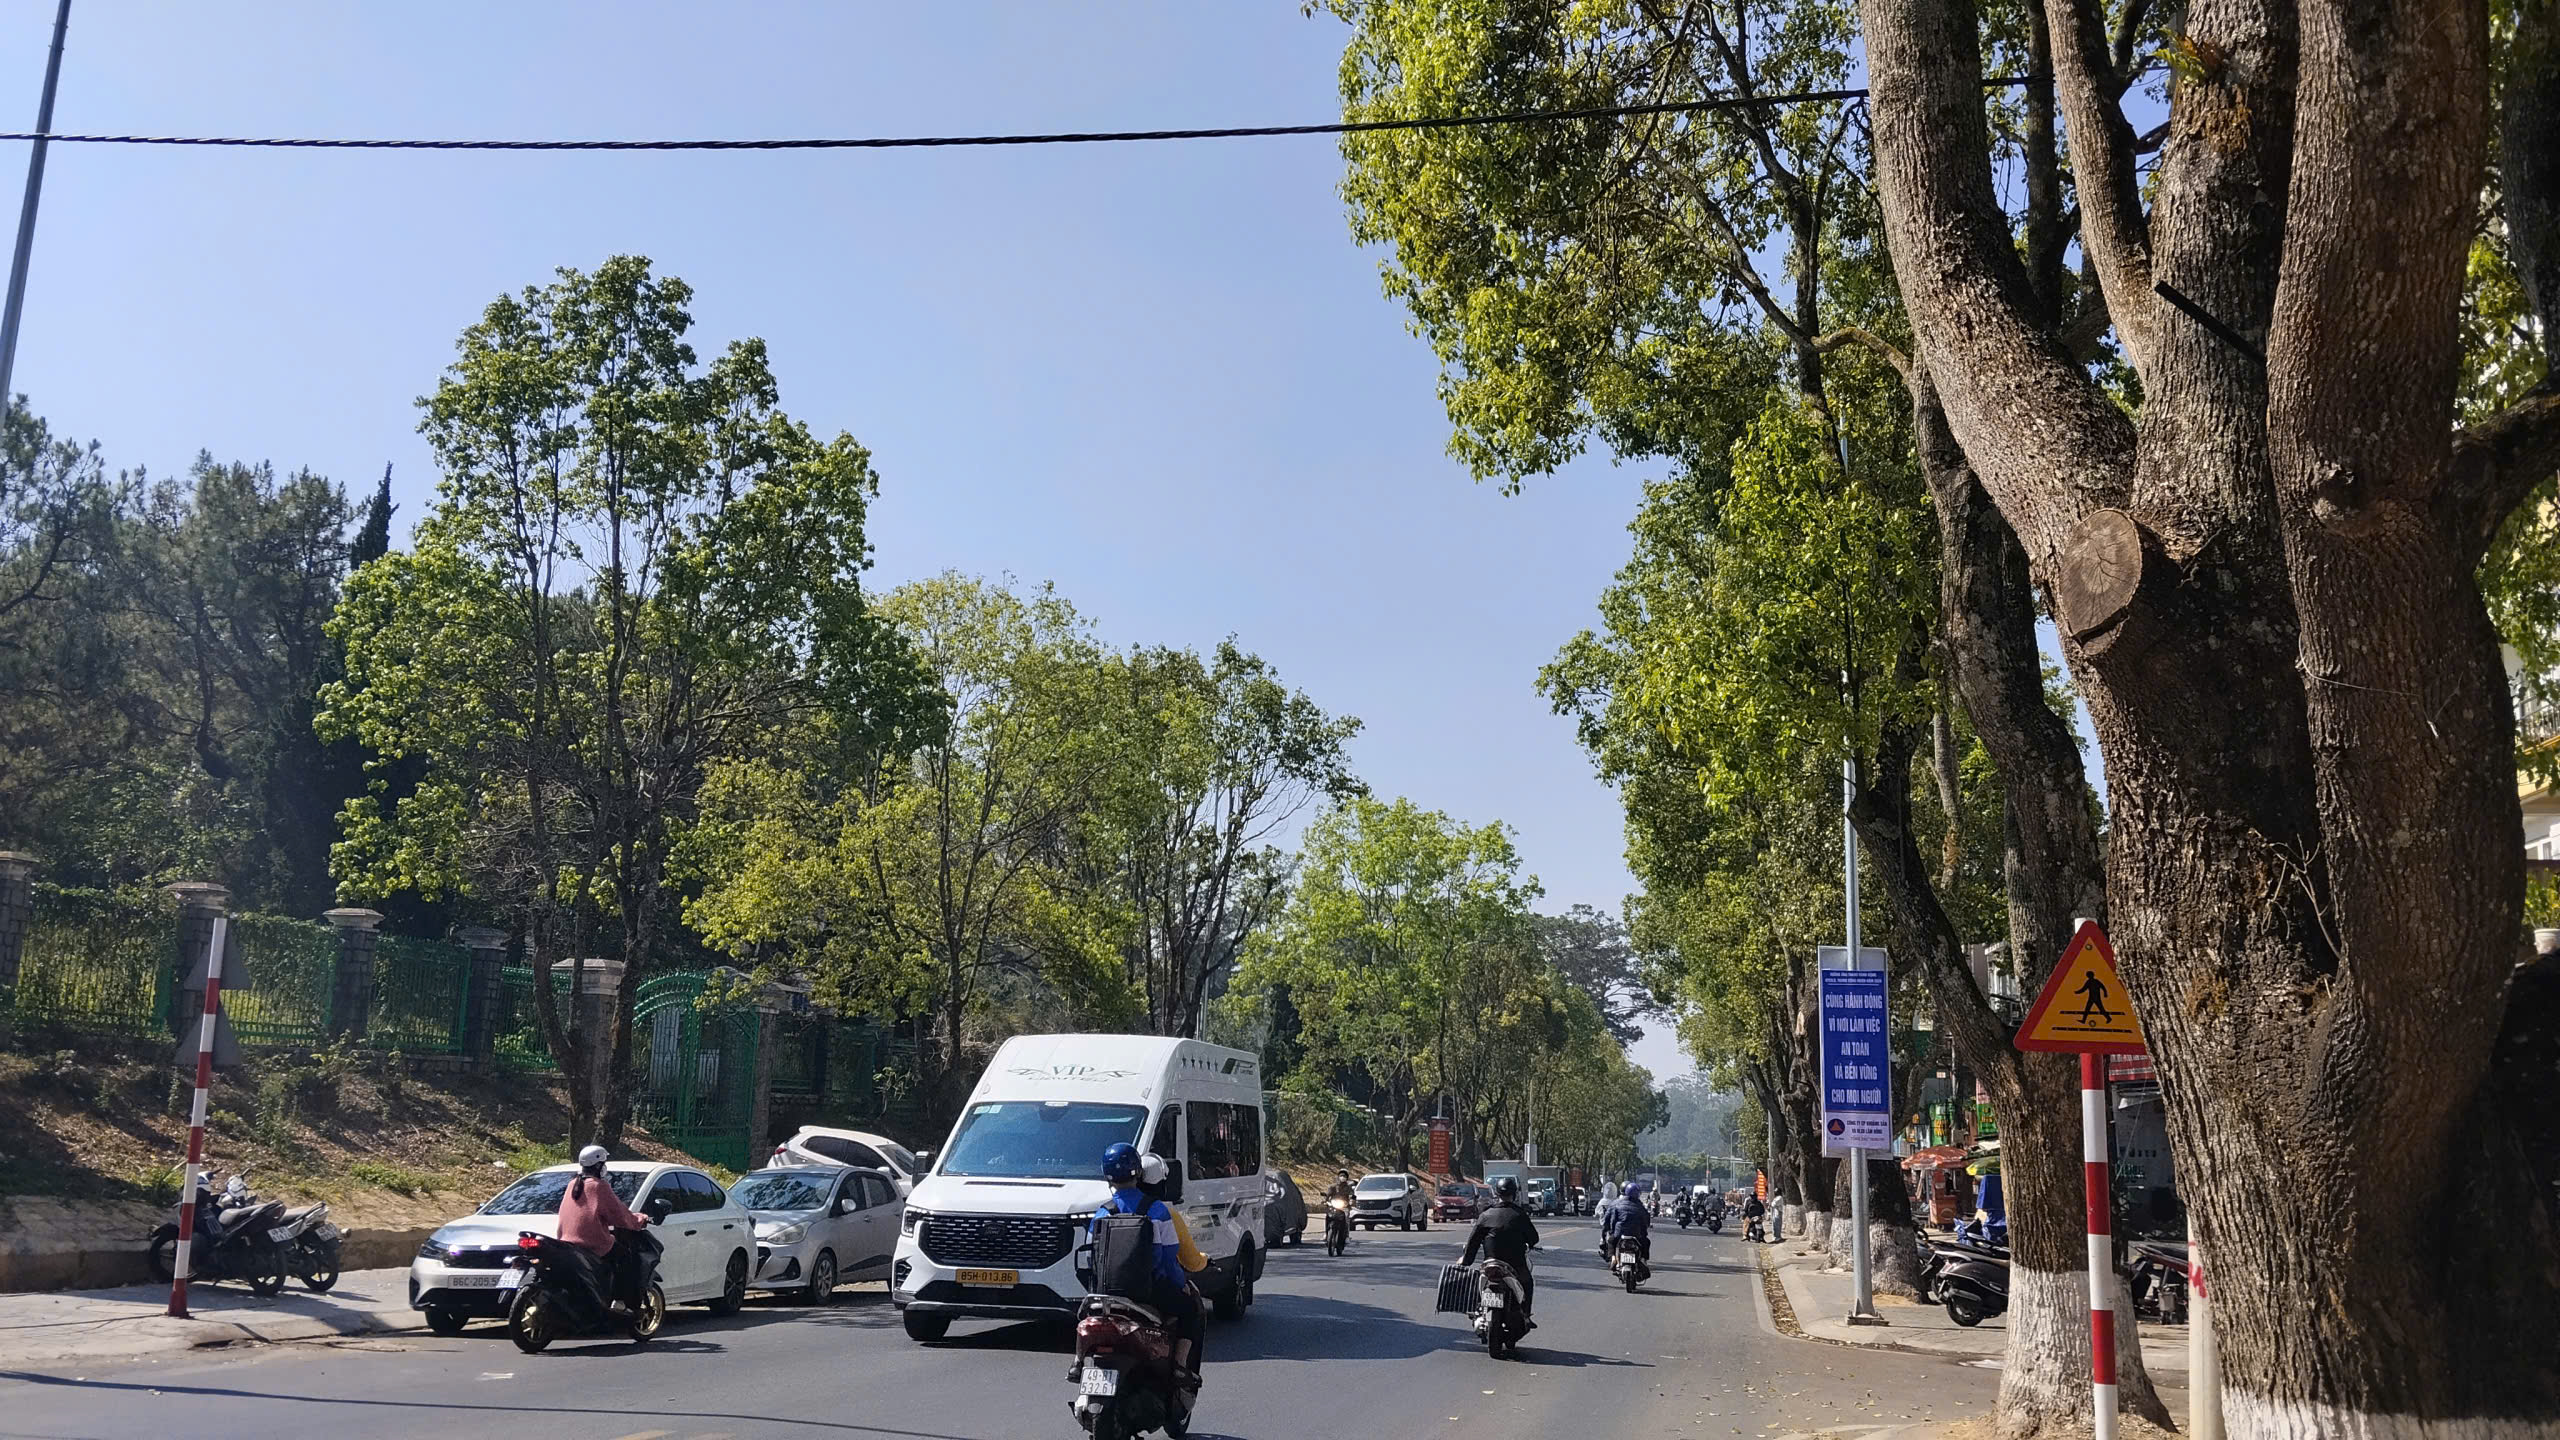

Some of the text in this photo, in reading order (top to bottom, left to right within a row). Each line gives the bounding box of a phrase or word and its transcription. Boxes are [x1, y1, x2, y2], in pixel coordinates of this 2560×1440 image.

[1825, 991, 1883, 1012] CÙNG HÀNH ĐỘNG
[1828, 1014, 1881, 1036] VÌ NƠI LÀM VIỆC
[1841, 1040, 1870, 1056] AN TOÀN
[1052, 1064, 1096, 1076] VIP
[1834, 1062, 1844, 1080] VÀ
[1858, 1063, 1878, 1081] VỮNG
[1831, 1086, 1882, 1107] CHO MỌI NGƯỜI
[960, 1270, 1013, 1282] 85H-013.86
